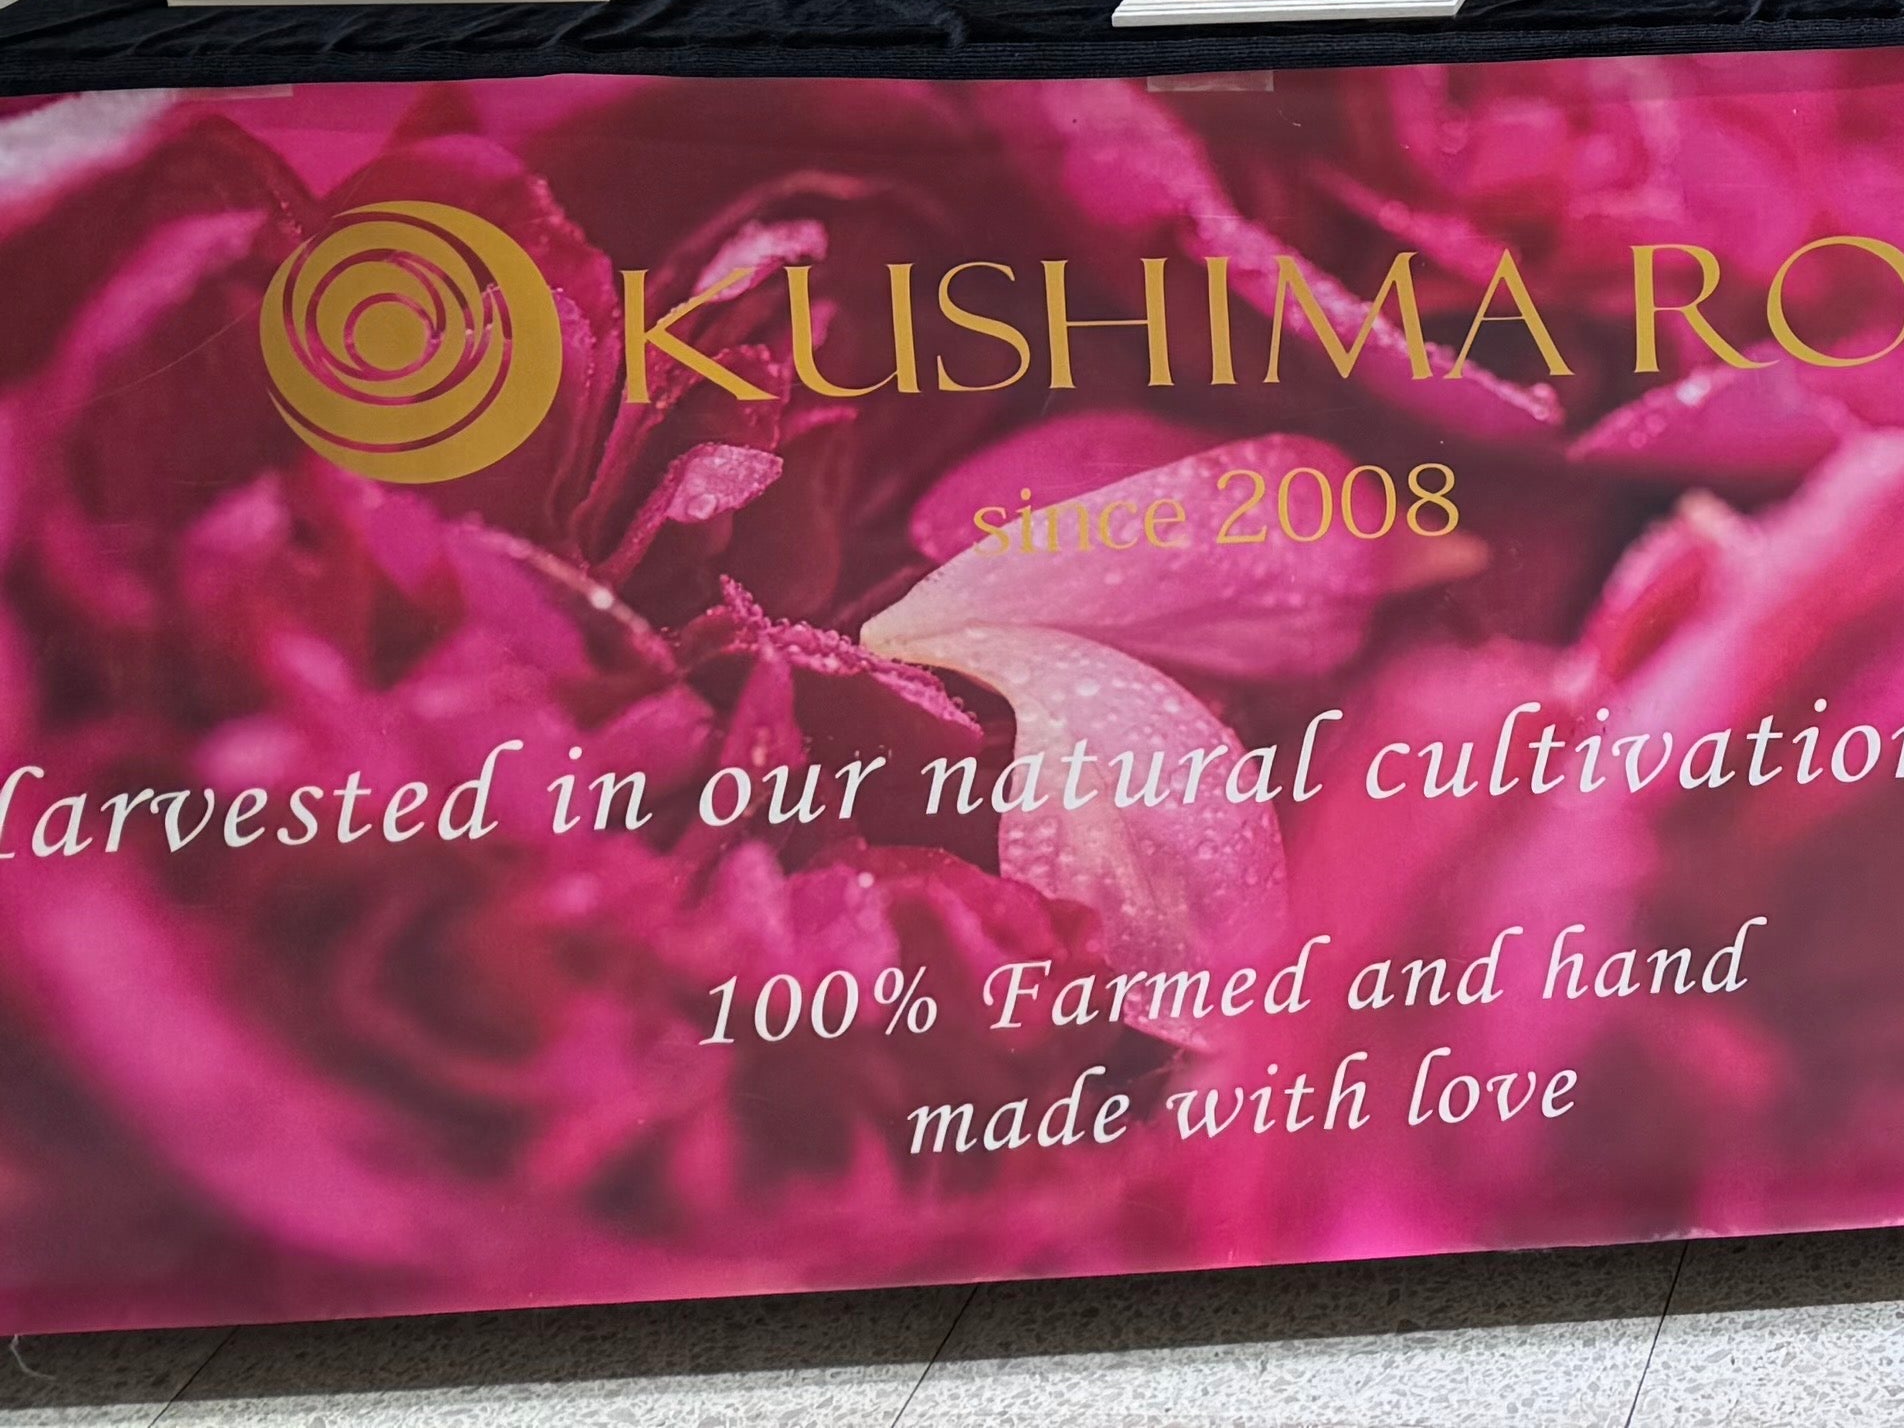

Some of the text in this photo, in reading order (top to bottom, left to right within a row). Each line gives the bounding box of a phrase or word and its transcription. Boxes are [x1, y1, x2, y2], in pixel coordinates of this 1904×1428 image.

[622, 248, 1576, 404] KUSHIMA
[972, 462, 1461, 558] since 2008
[548, 745, 653, 834] in
[698, 760, 889, 830] our
[921, 708, 1345, 818] natural
[698, 915, 1769, 1047] 100% Farmed and hand
[907, 1046, 1580, 1157] made with love
